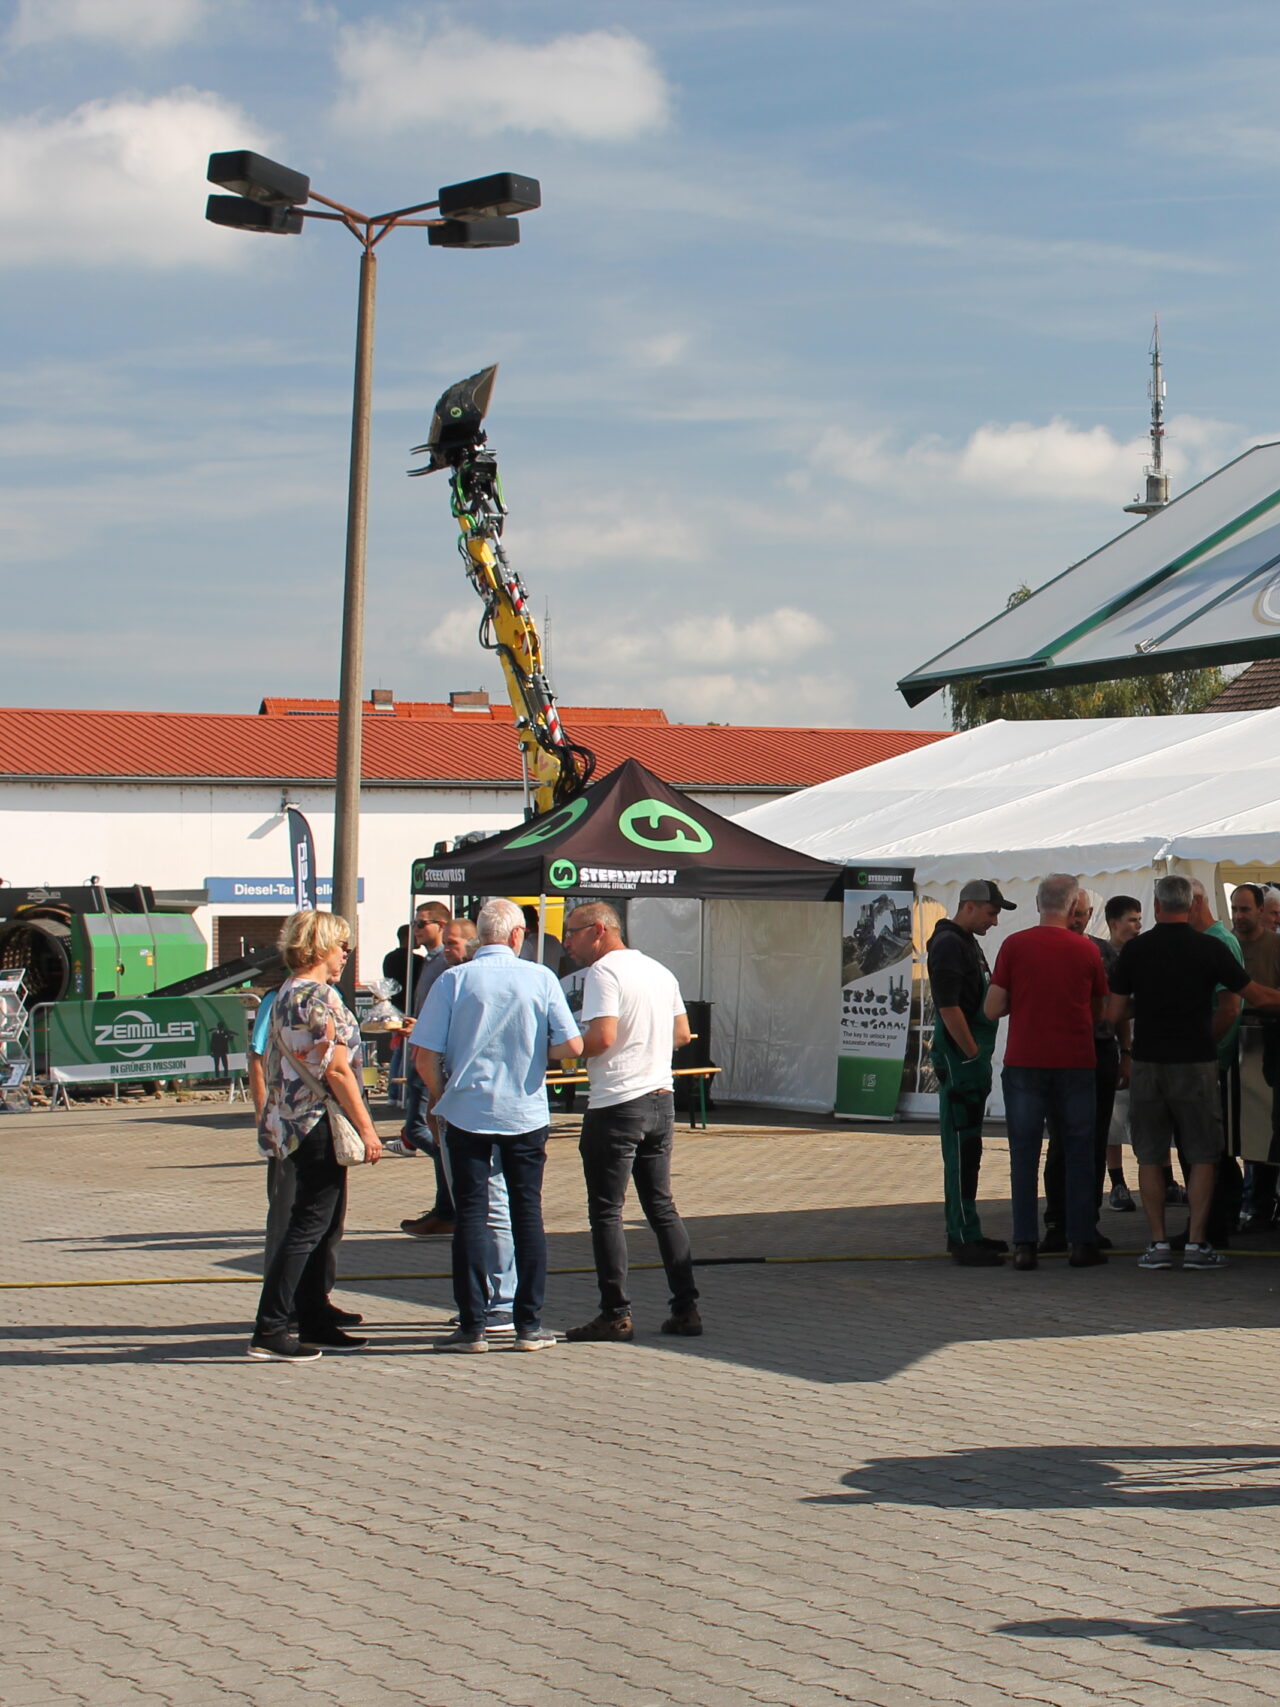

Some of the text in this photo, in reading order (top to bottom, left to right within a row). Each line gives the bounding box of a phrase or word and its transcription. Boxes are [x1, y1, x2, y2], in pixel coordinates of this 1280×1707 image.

[425, 868, 466, 882] STEELWRIST
[580, 867, 677, 884] STEELWRIST
[94, 1020, 196, 1046] ZEMMLER
[110, 1059, 187, 1075] IN GRÜNER MISSION
